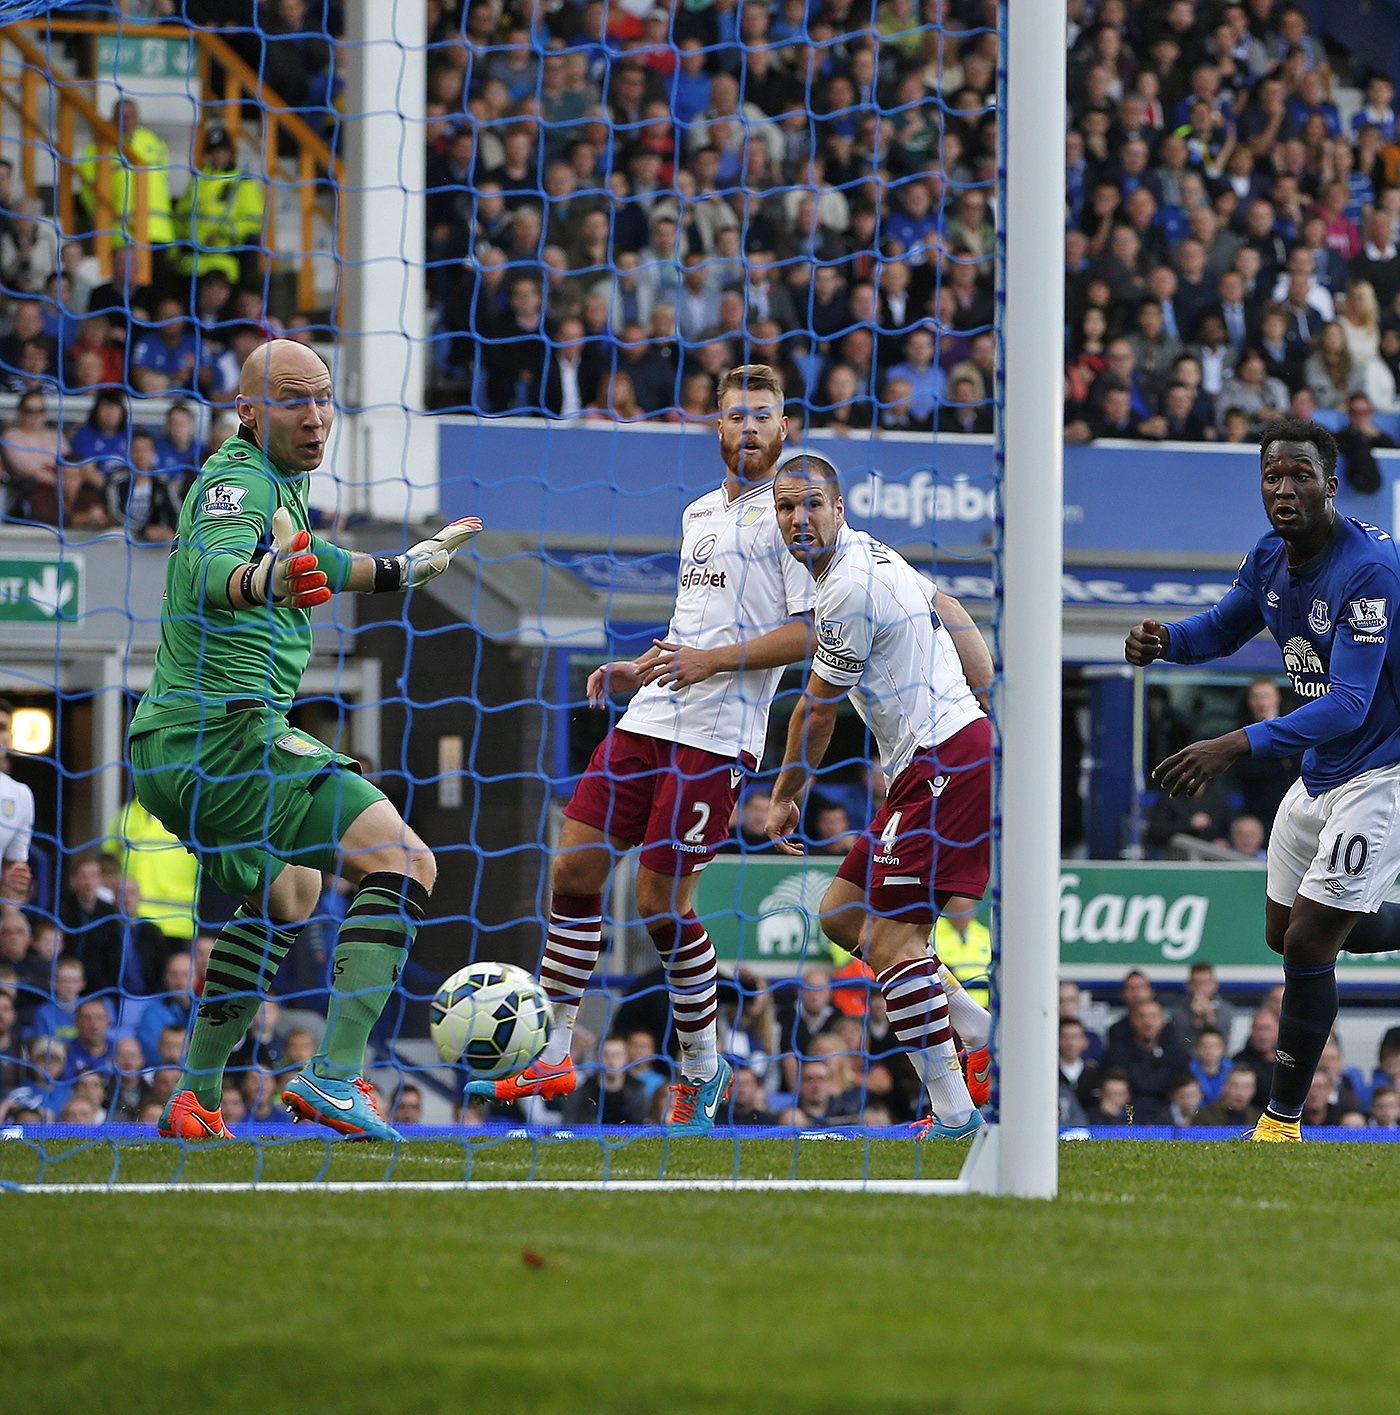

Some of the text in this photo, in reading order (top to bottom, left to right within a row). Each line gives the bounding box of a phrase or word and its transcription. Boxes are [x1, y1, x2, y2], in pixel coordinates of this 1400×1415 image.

[849, 470, 996, 529] dafab
[682, 568, 727, 590] afabet
[1353, 634, 1385, 644] umbro
[683, 801, 711, 844] 2
[880, 810, 903, 855] 4
[1327, 831, 1370, 878] 10
[1060, 872, 1209, 960] hang
